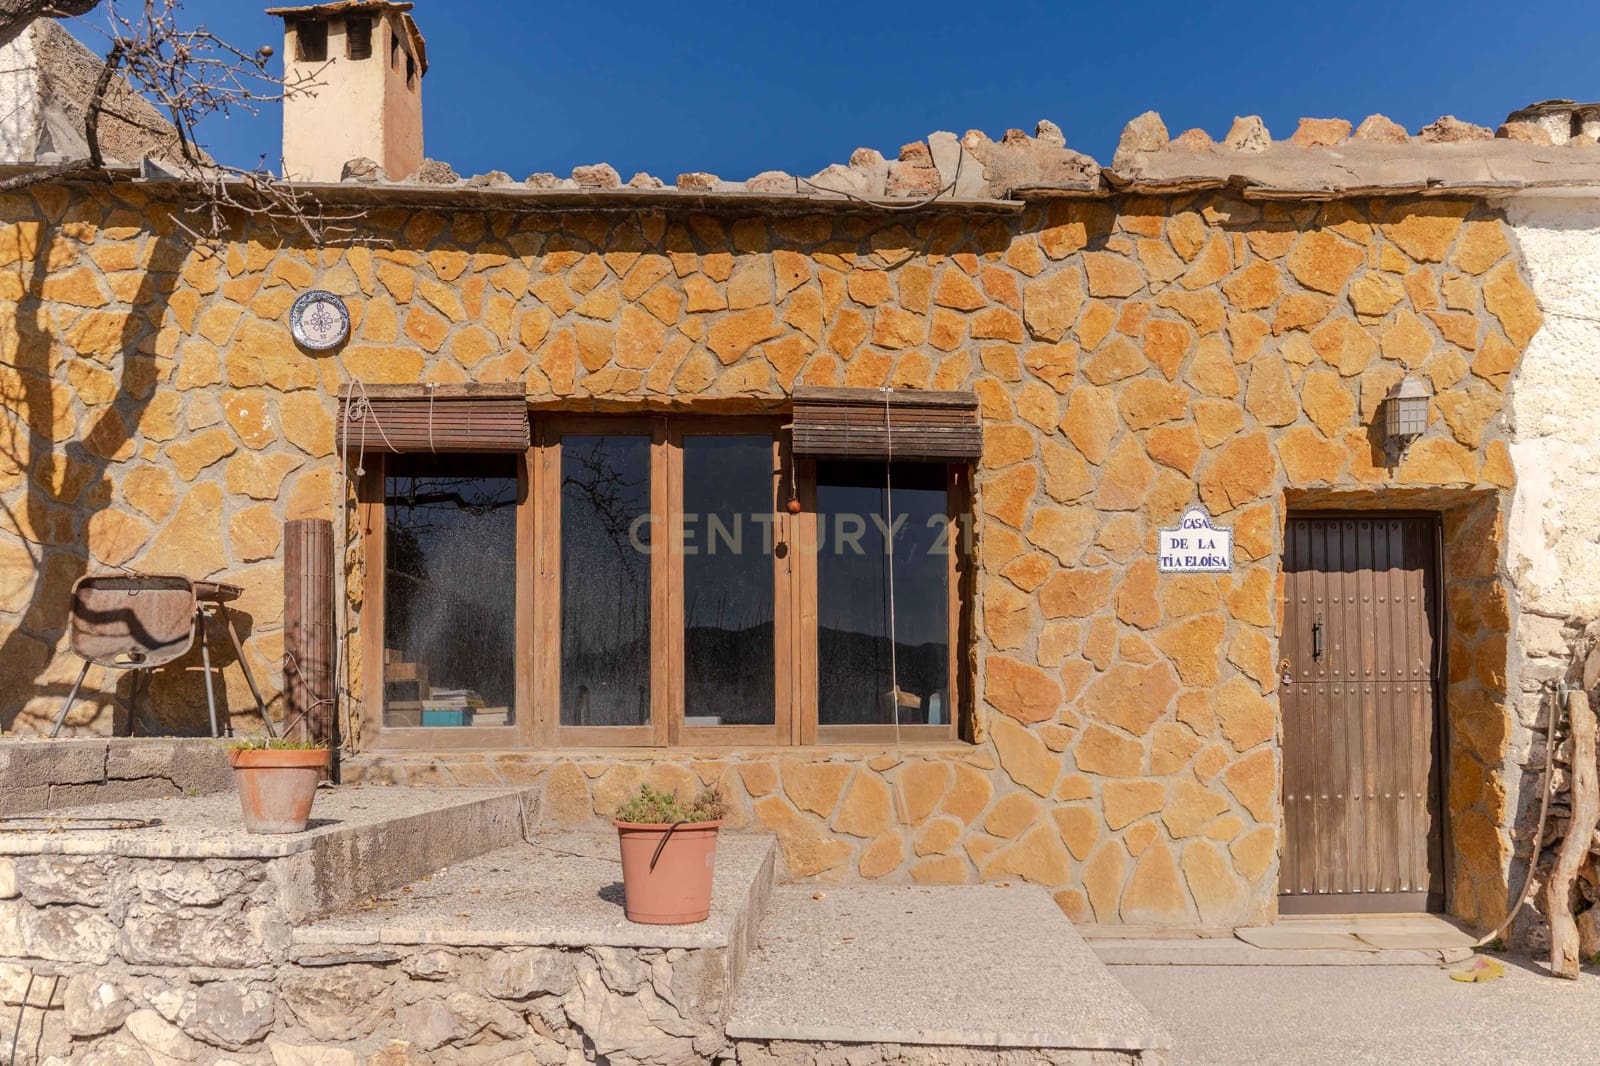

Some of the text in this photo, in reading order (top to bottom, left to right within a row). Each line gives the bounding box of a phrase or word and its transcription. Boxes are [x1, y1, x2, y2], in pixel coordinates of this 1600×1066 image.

[1183, 519, 1210, 529] CASA
[1170, 538, 1216, 549] DE LA
